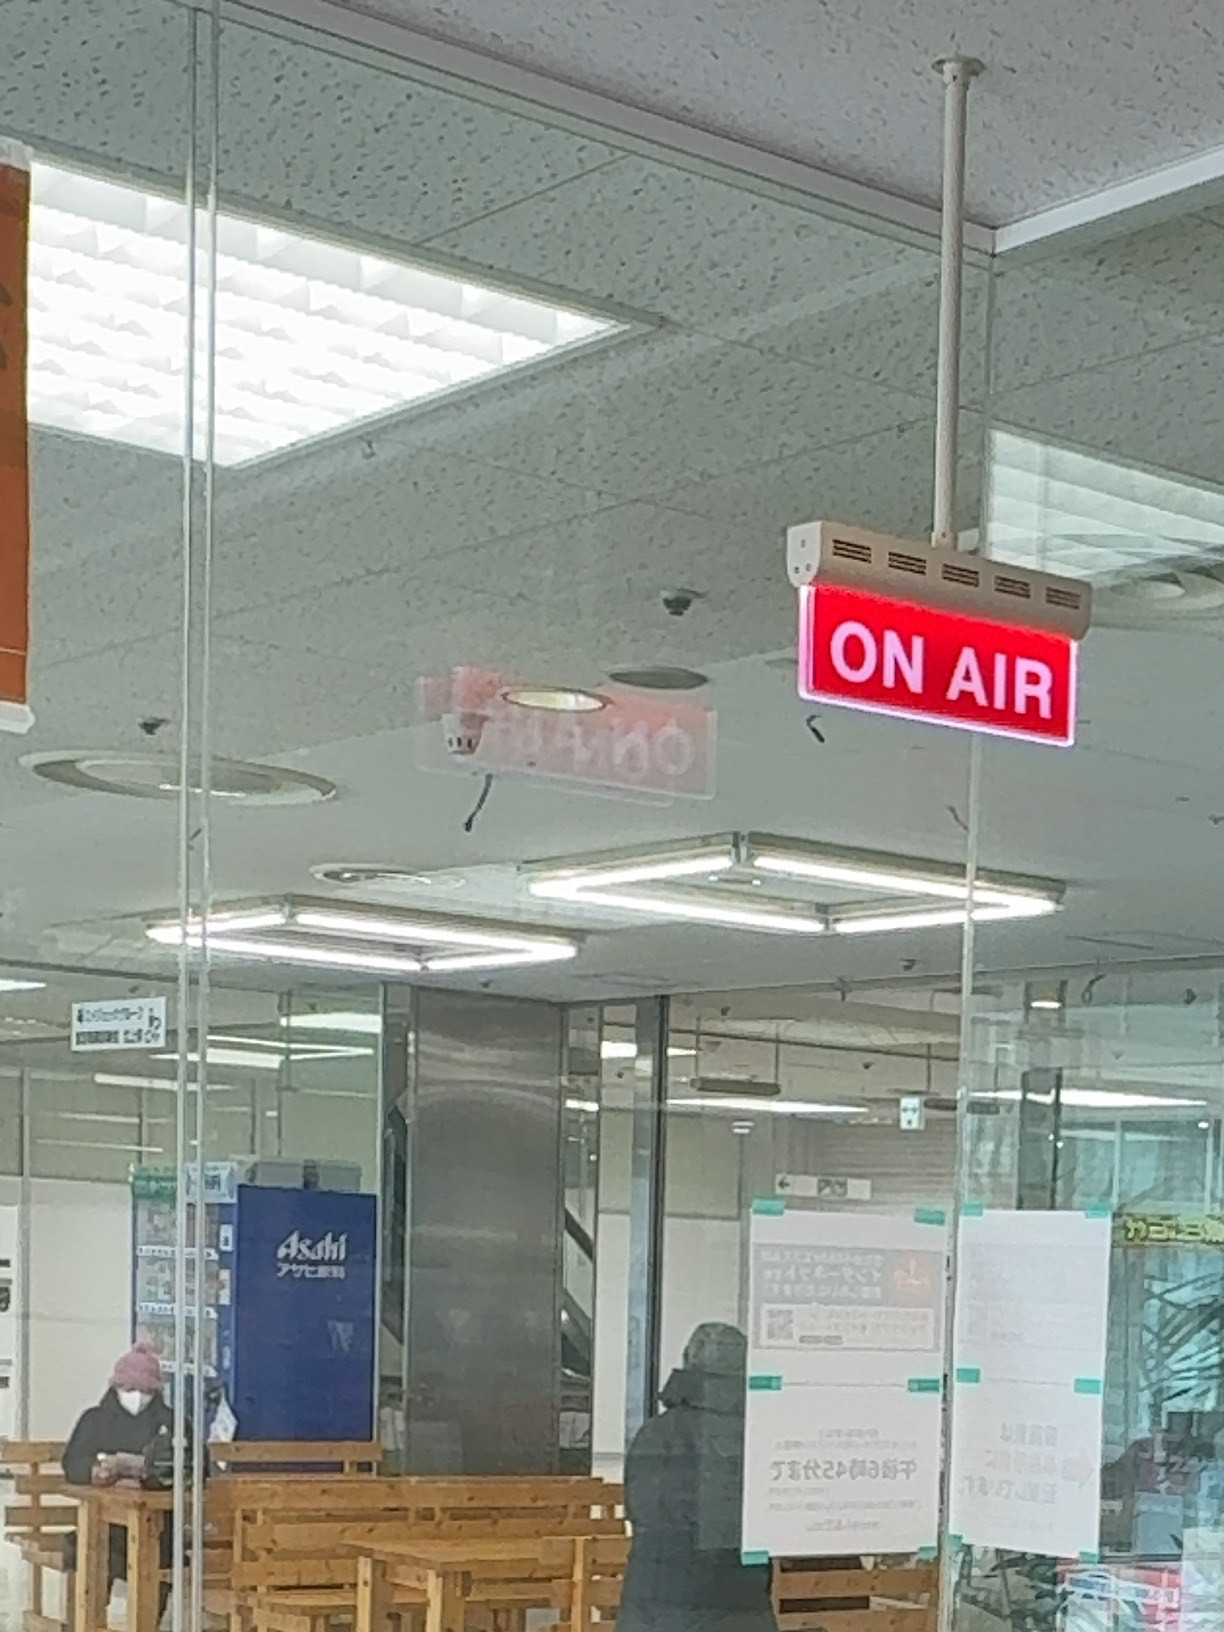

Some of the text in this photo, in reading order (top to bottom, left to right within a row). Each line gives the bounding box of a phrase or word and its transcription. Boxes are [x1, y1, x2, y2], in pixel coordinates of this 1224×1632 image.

[829, 621, 1054, 720] ON AIR
[276, 1230, 348, 1261] Asahi
